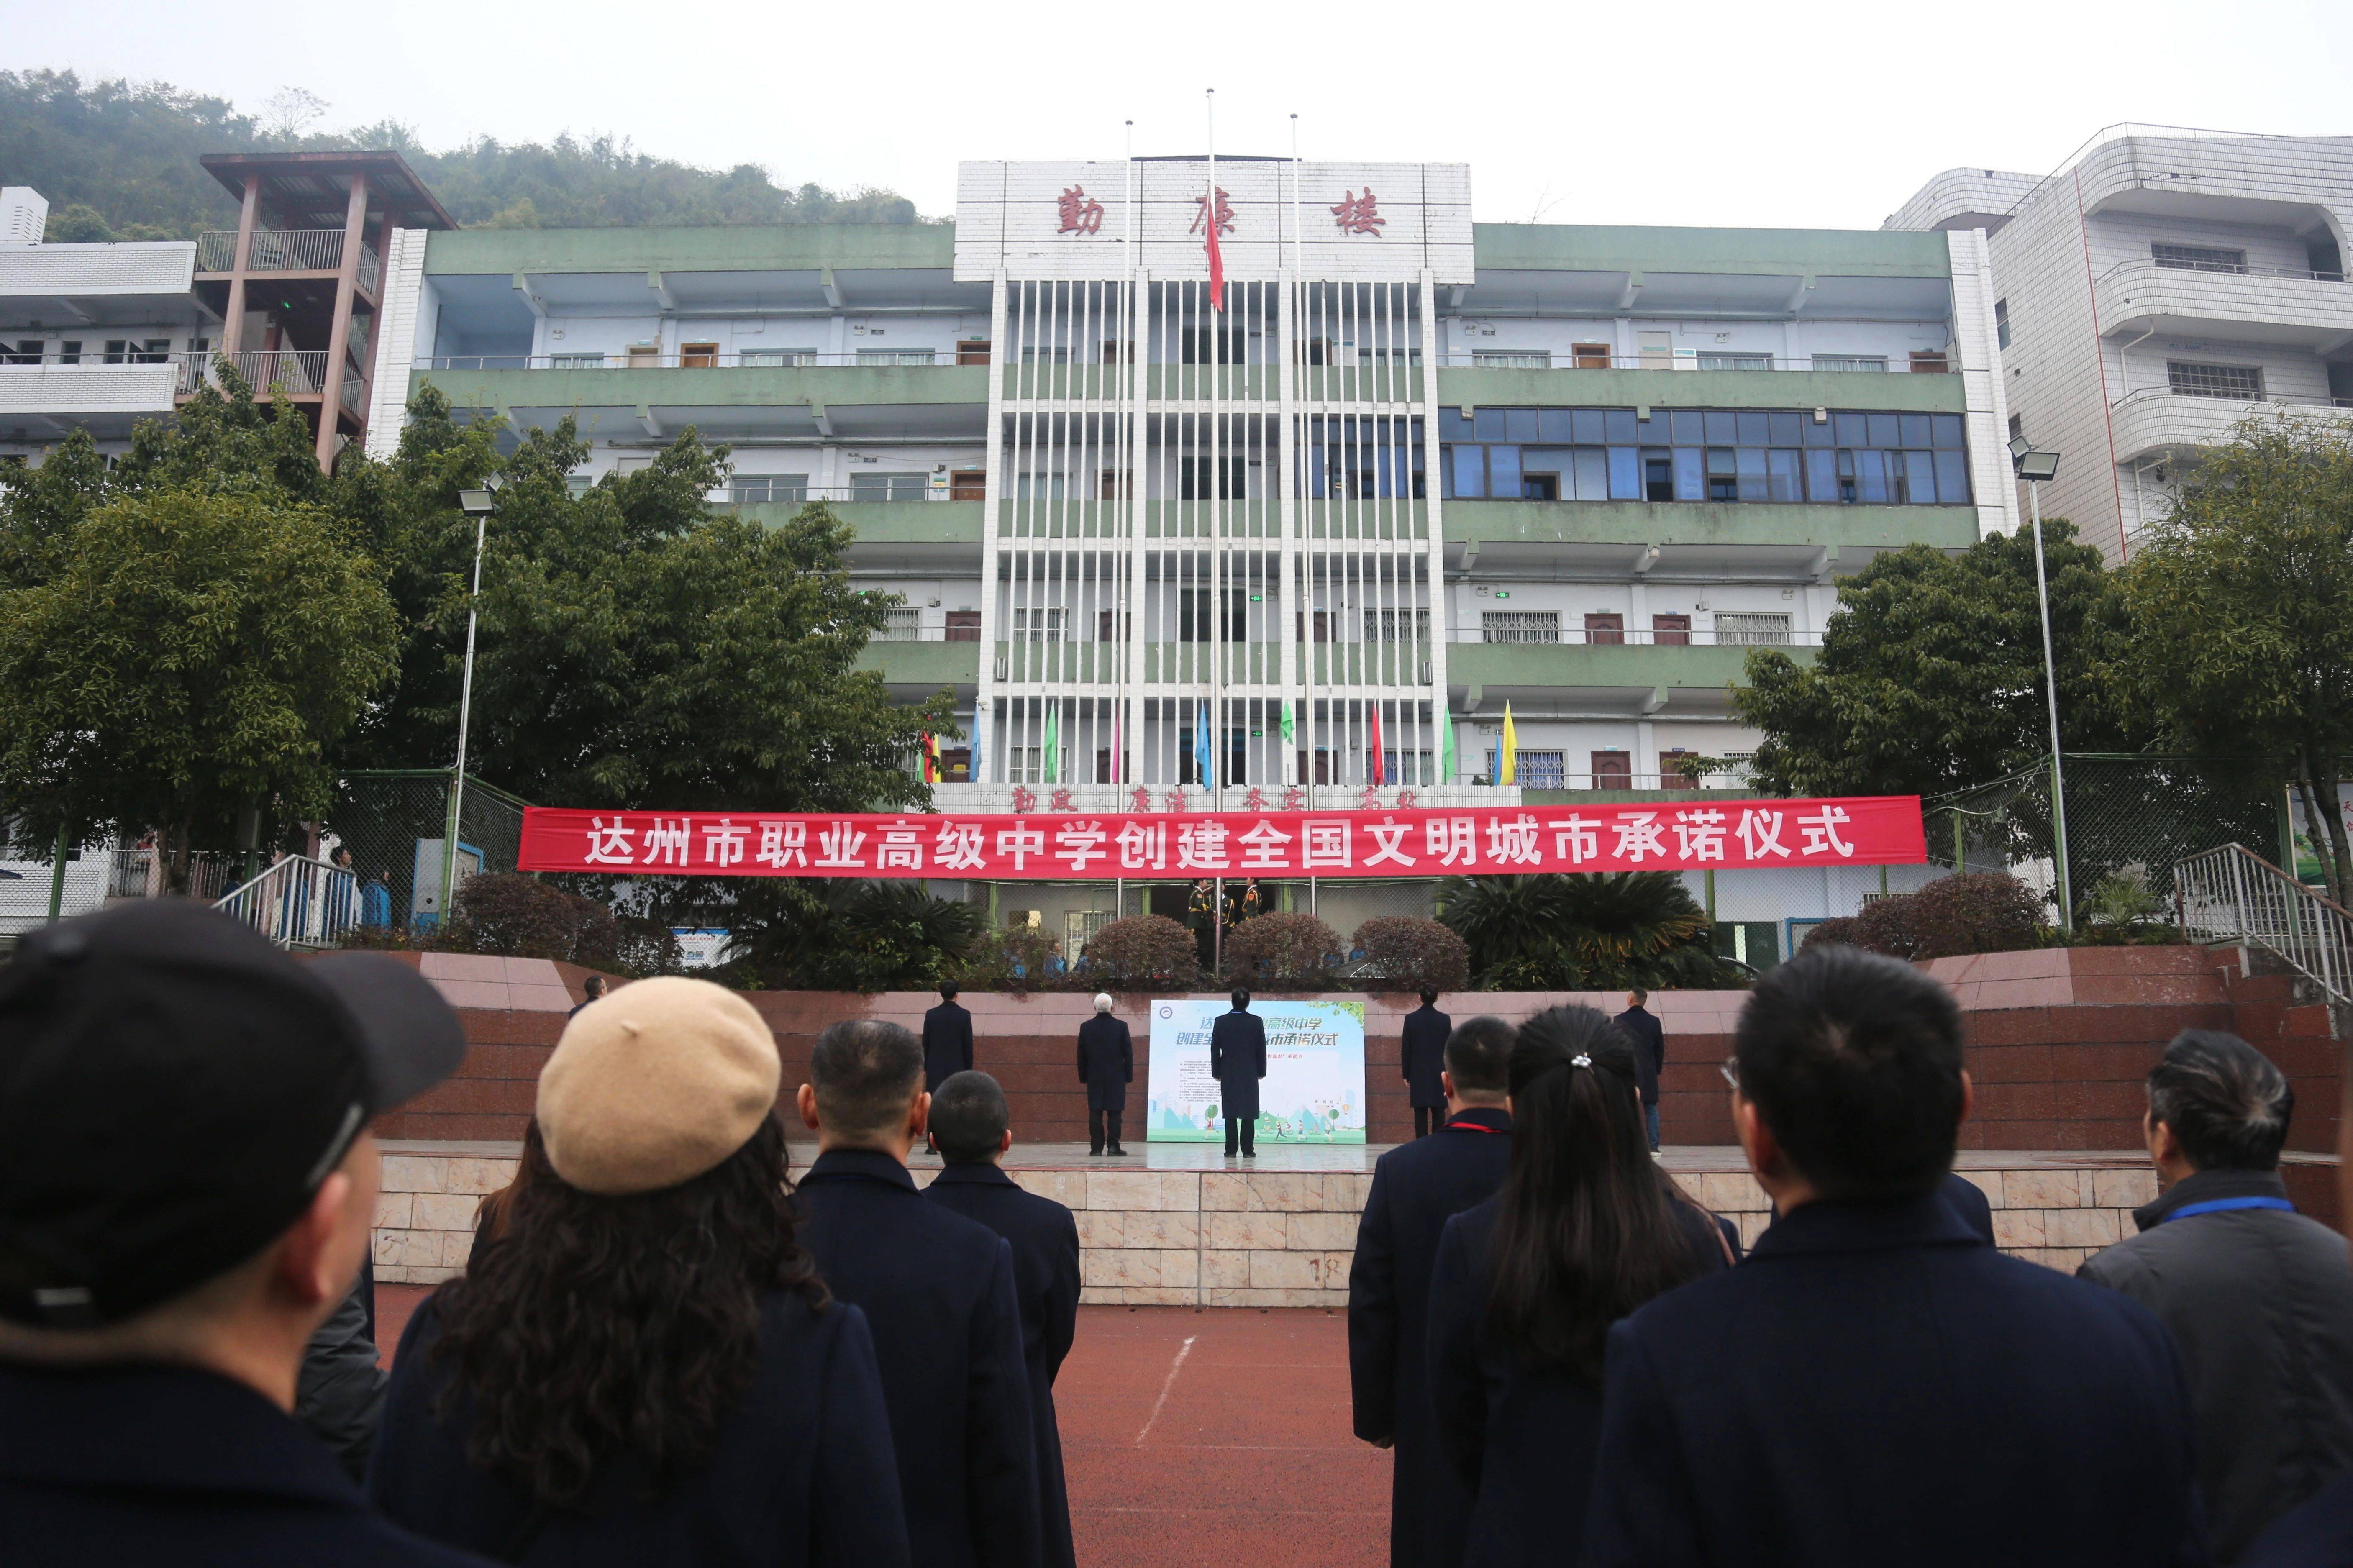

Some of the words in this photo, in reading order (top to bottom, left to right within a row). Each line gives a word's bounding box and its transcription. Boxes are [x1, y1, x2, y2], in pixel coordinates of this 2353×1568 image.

[1057, 184, 1386, 238] 勤廉楼
[1012, 786, 1078, 813] 勤政
[584, 805, 1854, 871] 达州市职业高级中学创建全国文明城市承诺仪式
[1176, 1033, 1338, 1045] 创建全市承诺仪式
